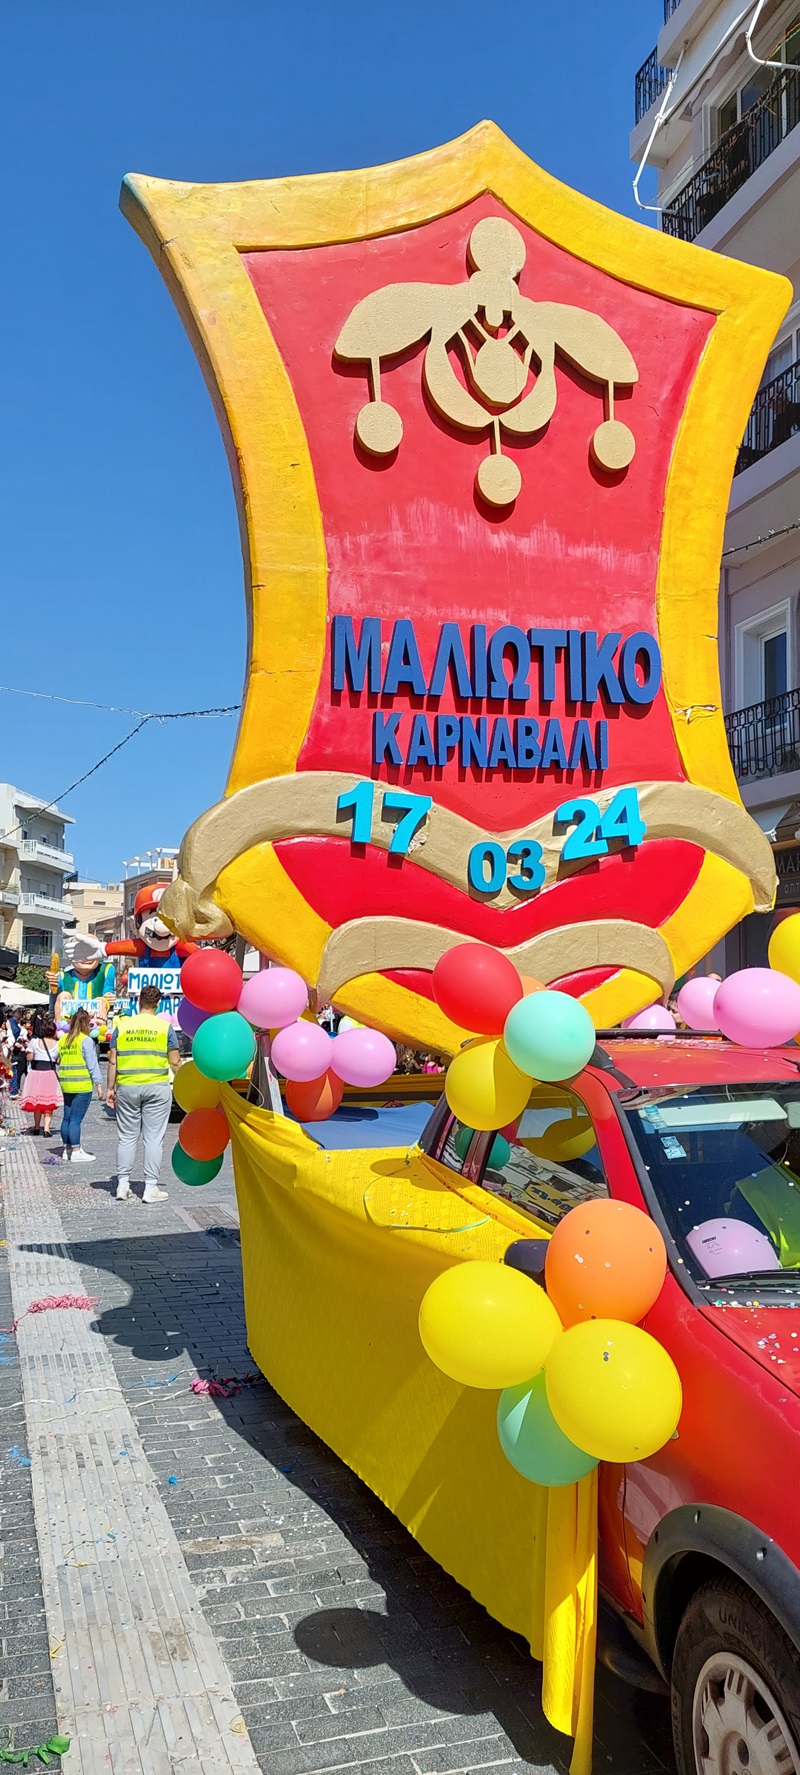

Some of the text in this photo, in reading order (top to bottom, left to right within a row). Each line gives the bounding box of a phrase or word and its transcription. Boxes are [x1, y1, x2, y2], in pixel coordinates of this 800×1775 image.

[332, 615, 662, 704] ΜΑΛΙΩΤΙΚΟ
[373, 711, 608, 770] ΚΑΡΝΑΒΑΛΙ
[337, 781, 647, 893] 17 03 24
